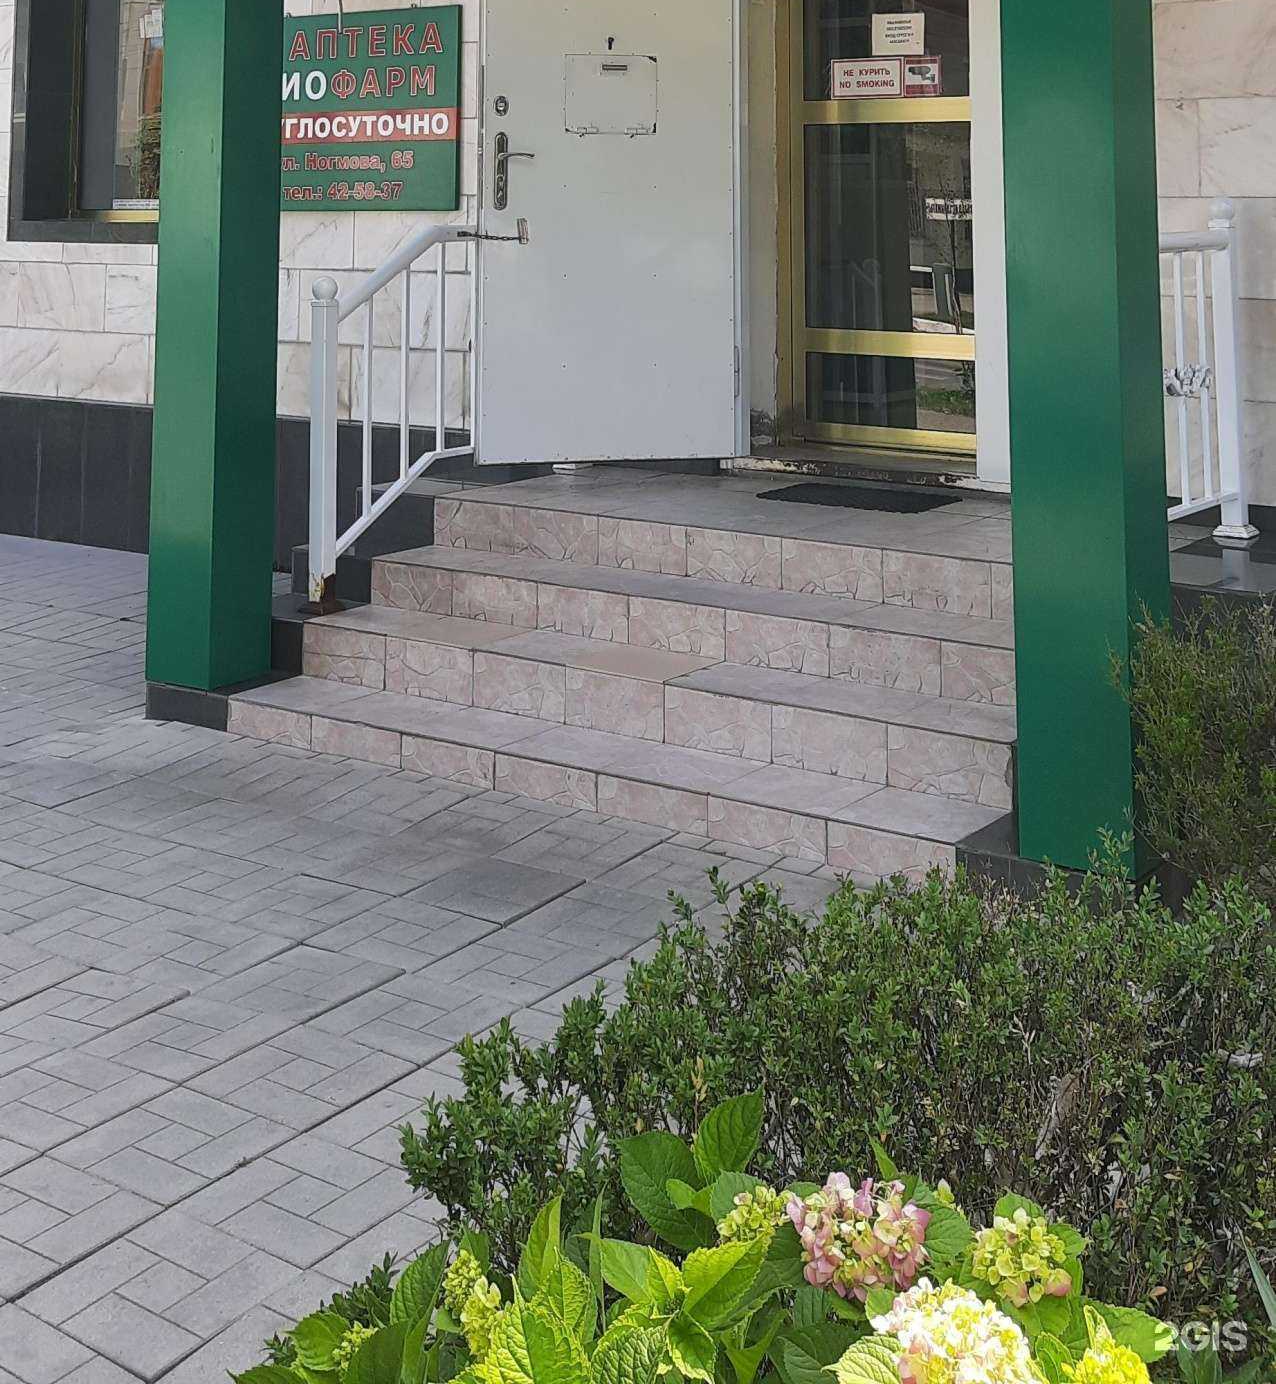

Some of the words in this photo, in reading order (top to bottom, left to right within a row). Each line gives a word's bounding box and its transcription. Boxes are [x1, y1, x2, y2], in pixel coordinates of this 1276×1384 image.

[288, 22, 443, 61] АПТЕКА
[843, 69, 855, 77] НЕ
[859, 68, 891, 76] КУРИТЬ
[839, 80, 852, 89] NO
[856, 79, 895, 89] SMOKING
[281, 113, 449, 139] ГЛОСУТОЧНО
[304, 152, 386, 174] Ногмова,
[391, 150, 415, 169] 65
[327, 181, 403, 201] 42-58-37
